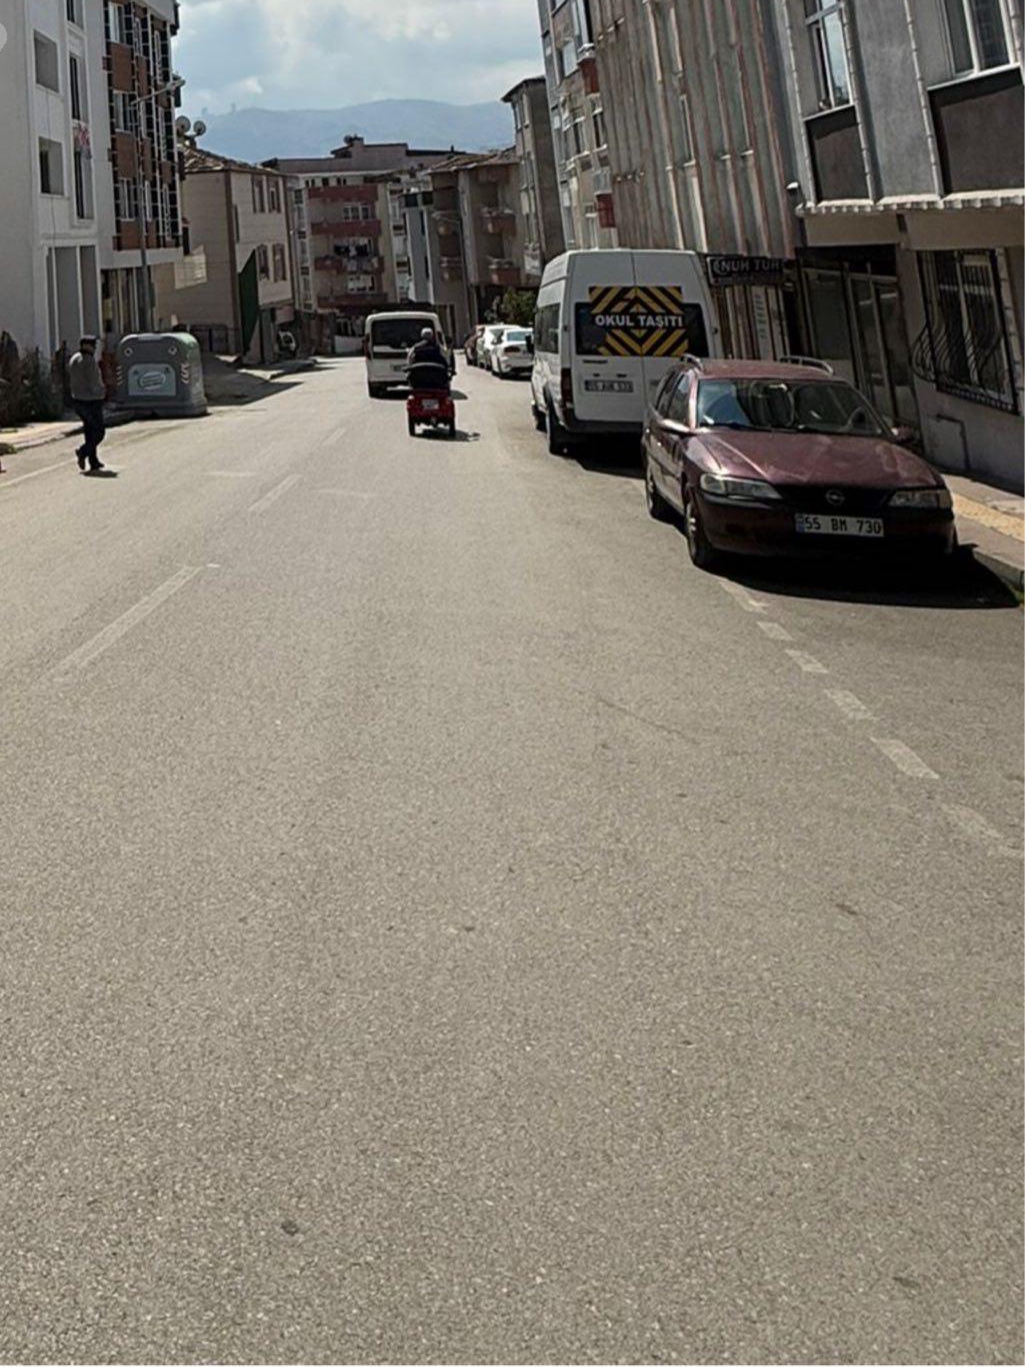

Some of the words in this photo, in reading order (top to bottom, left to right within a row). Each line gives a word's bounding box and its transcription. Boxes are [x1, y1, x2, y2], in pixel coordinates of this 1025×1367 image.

[594, 315, 634, 327] OKUL
[637, 315, 684, 329] TAŞITI
[805, 517, 821, 530] 55
[831, 518, 847, 531] BM
[857, 520, 881, 534] 730
